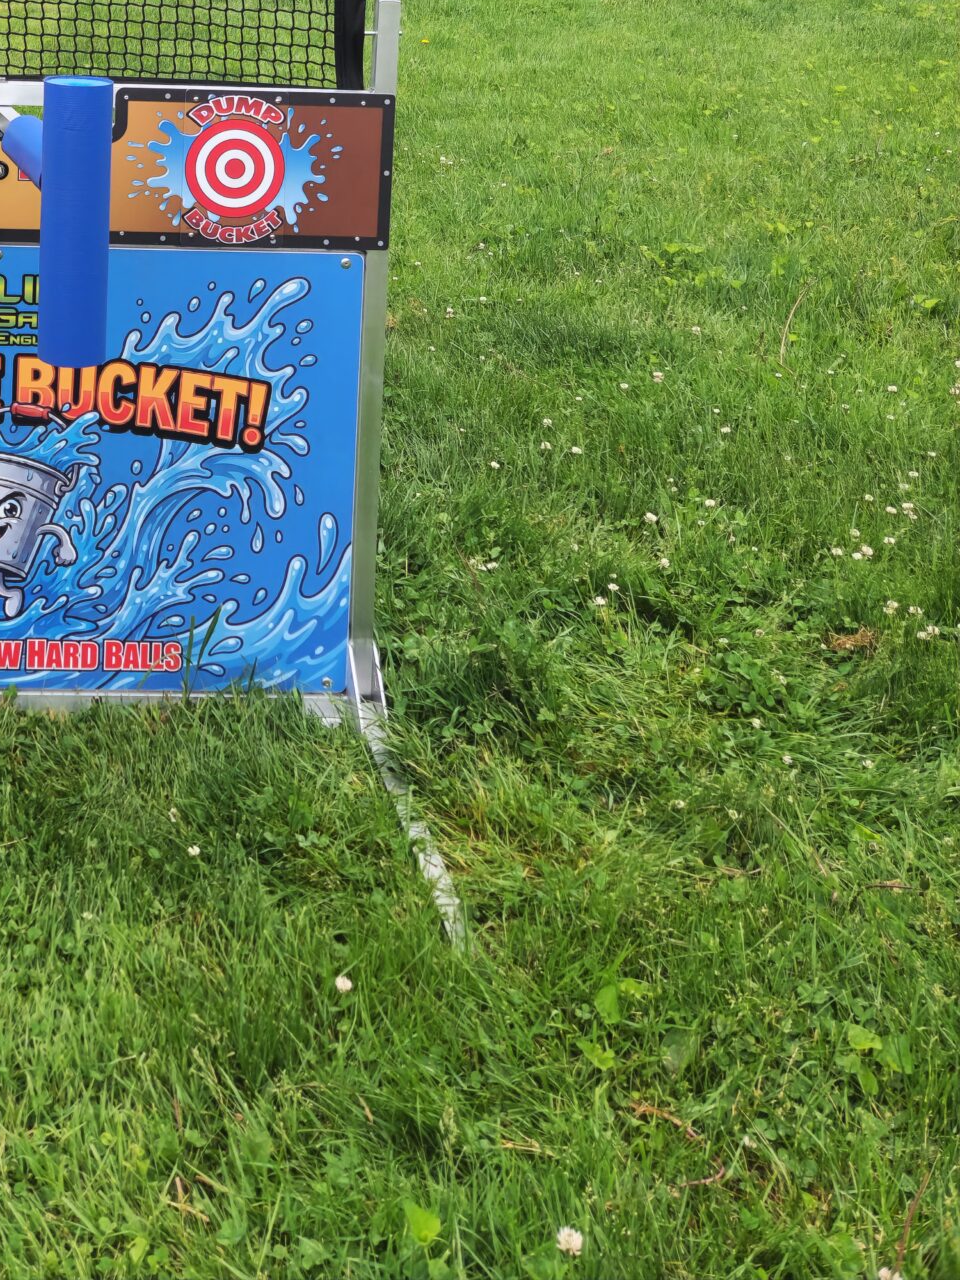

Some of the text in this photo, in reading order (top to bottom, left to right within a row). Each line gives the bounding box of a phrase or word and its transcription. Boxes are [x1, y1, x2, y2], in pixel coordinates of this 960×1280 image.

[187, 95, 285, 127] DUMP
[183, 206, 283, 244] BUCKET
[15, 354, 271, 451] BUCKET!
[25, 639, 98, 670] HARD
[103, 639, 182, 672] BALLS
